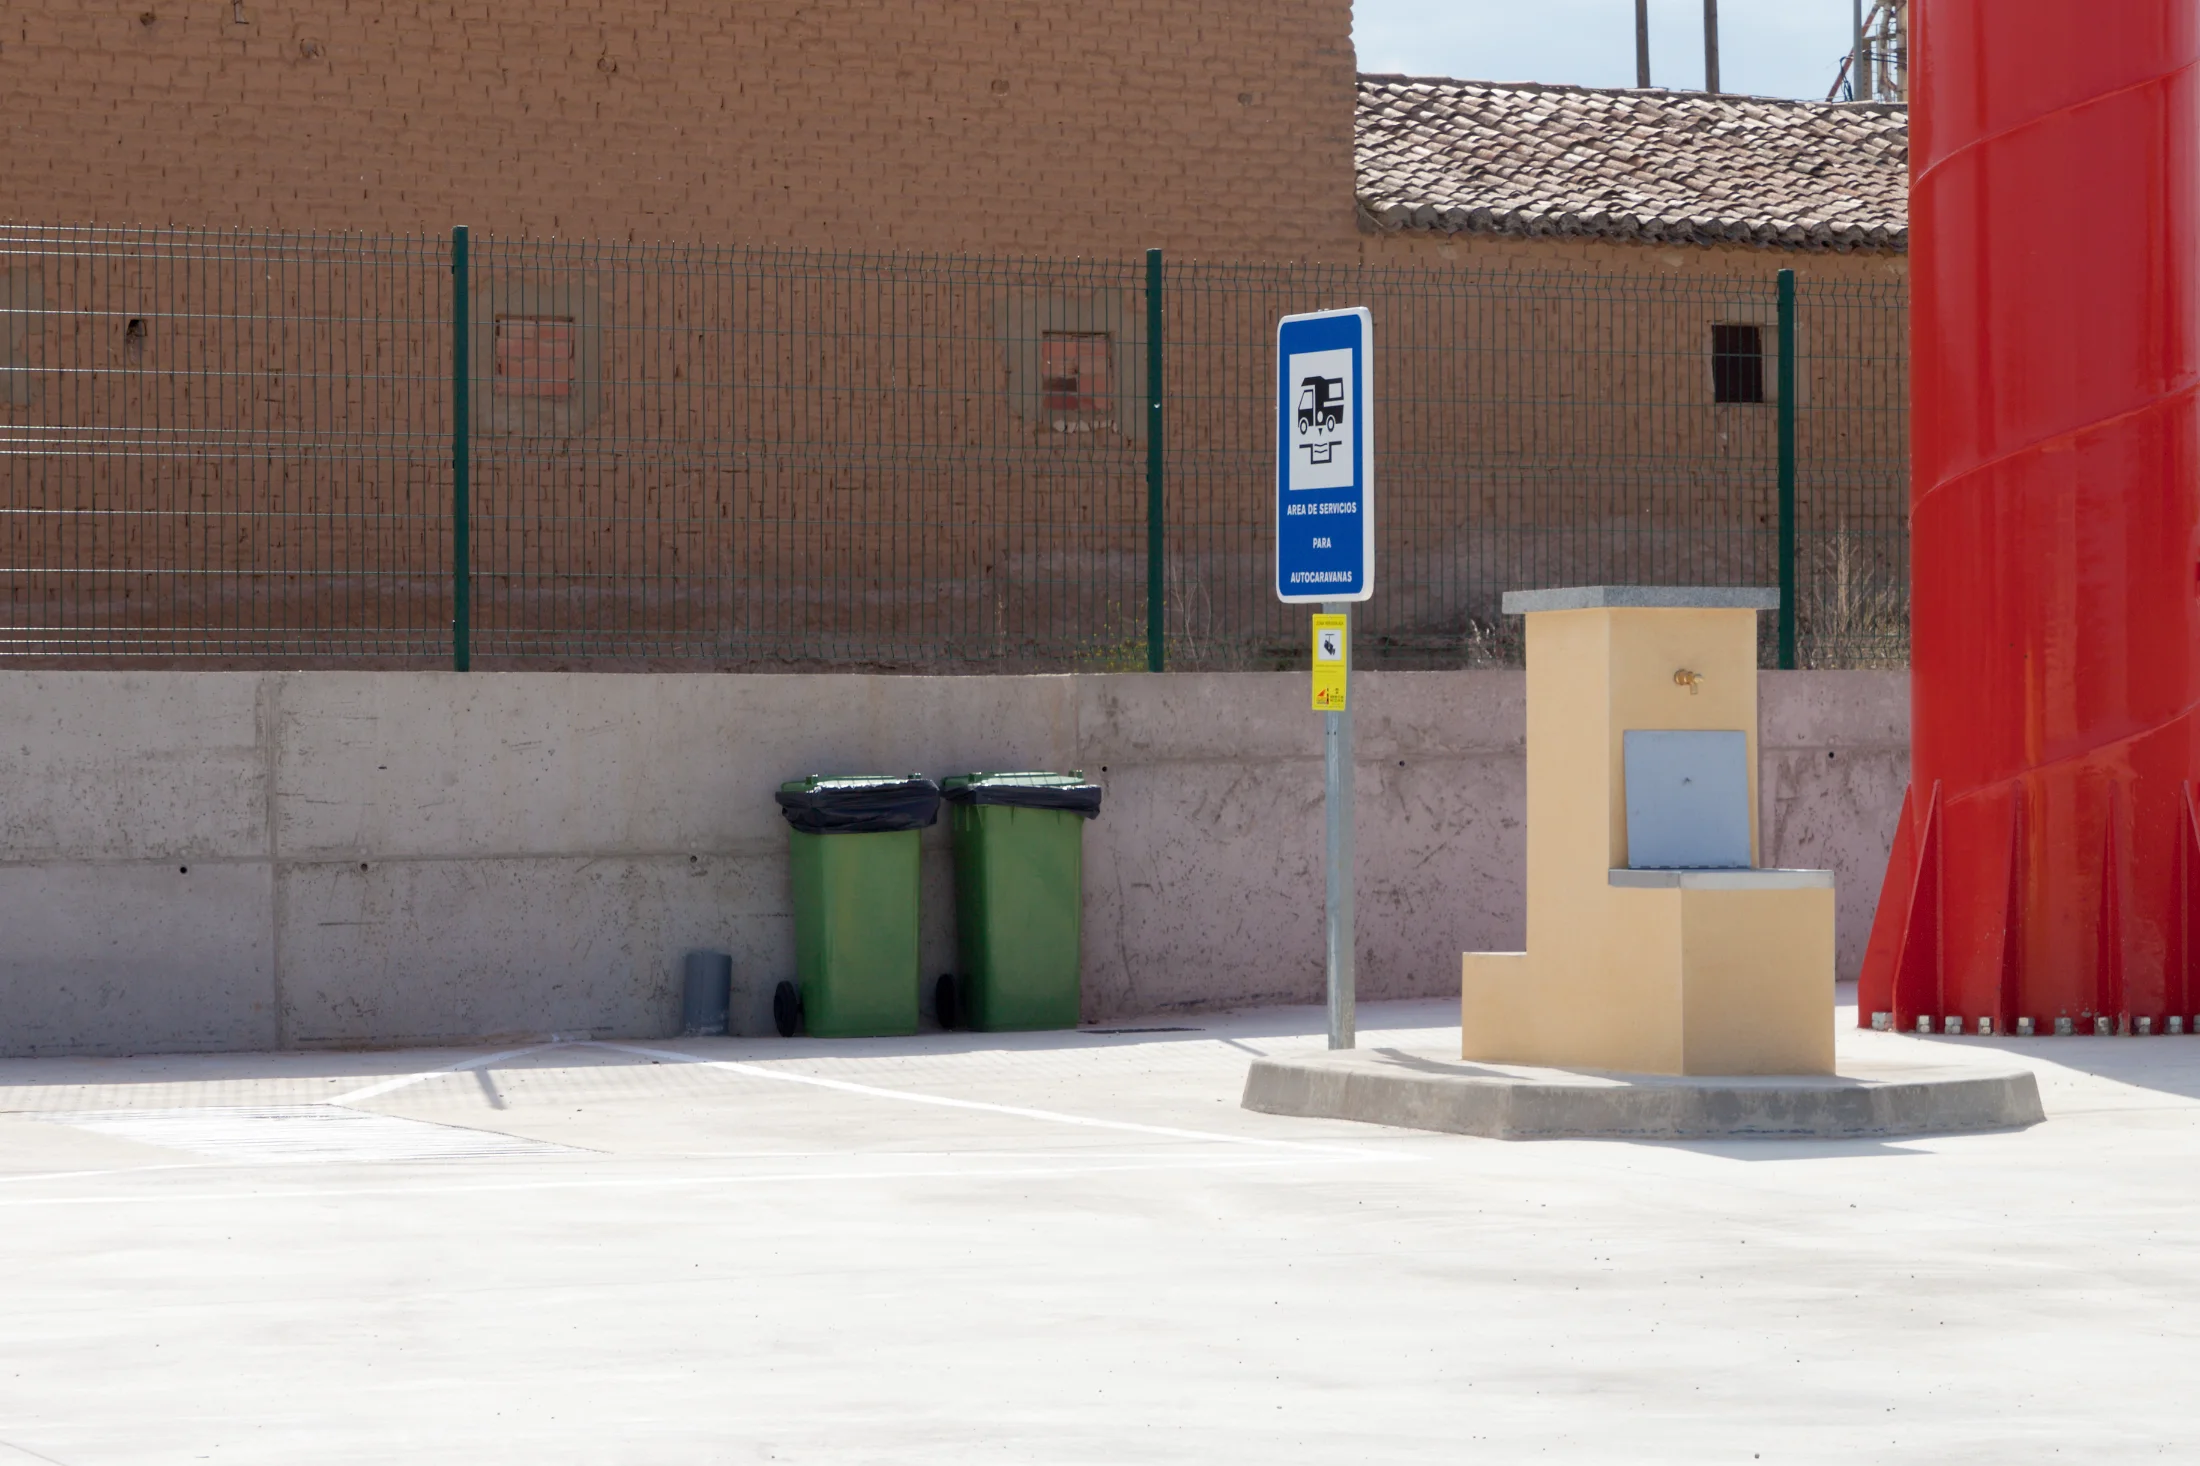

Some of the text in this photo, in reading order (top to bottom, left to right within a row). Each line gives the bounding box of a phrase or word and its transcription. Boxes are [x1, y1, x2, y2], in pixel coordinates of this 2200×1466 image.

[1287, 501, 1357, 516] AREA DE SERVICIOS
[1313, 537, 1332, 549] PARA
[1290, 571, 1352, 583] AUTOCARAVANAS
